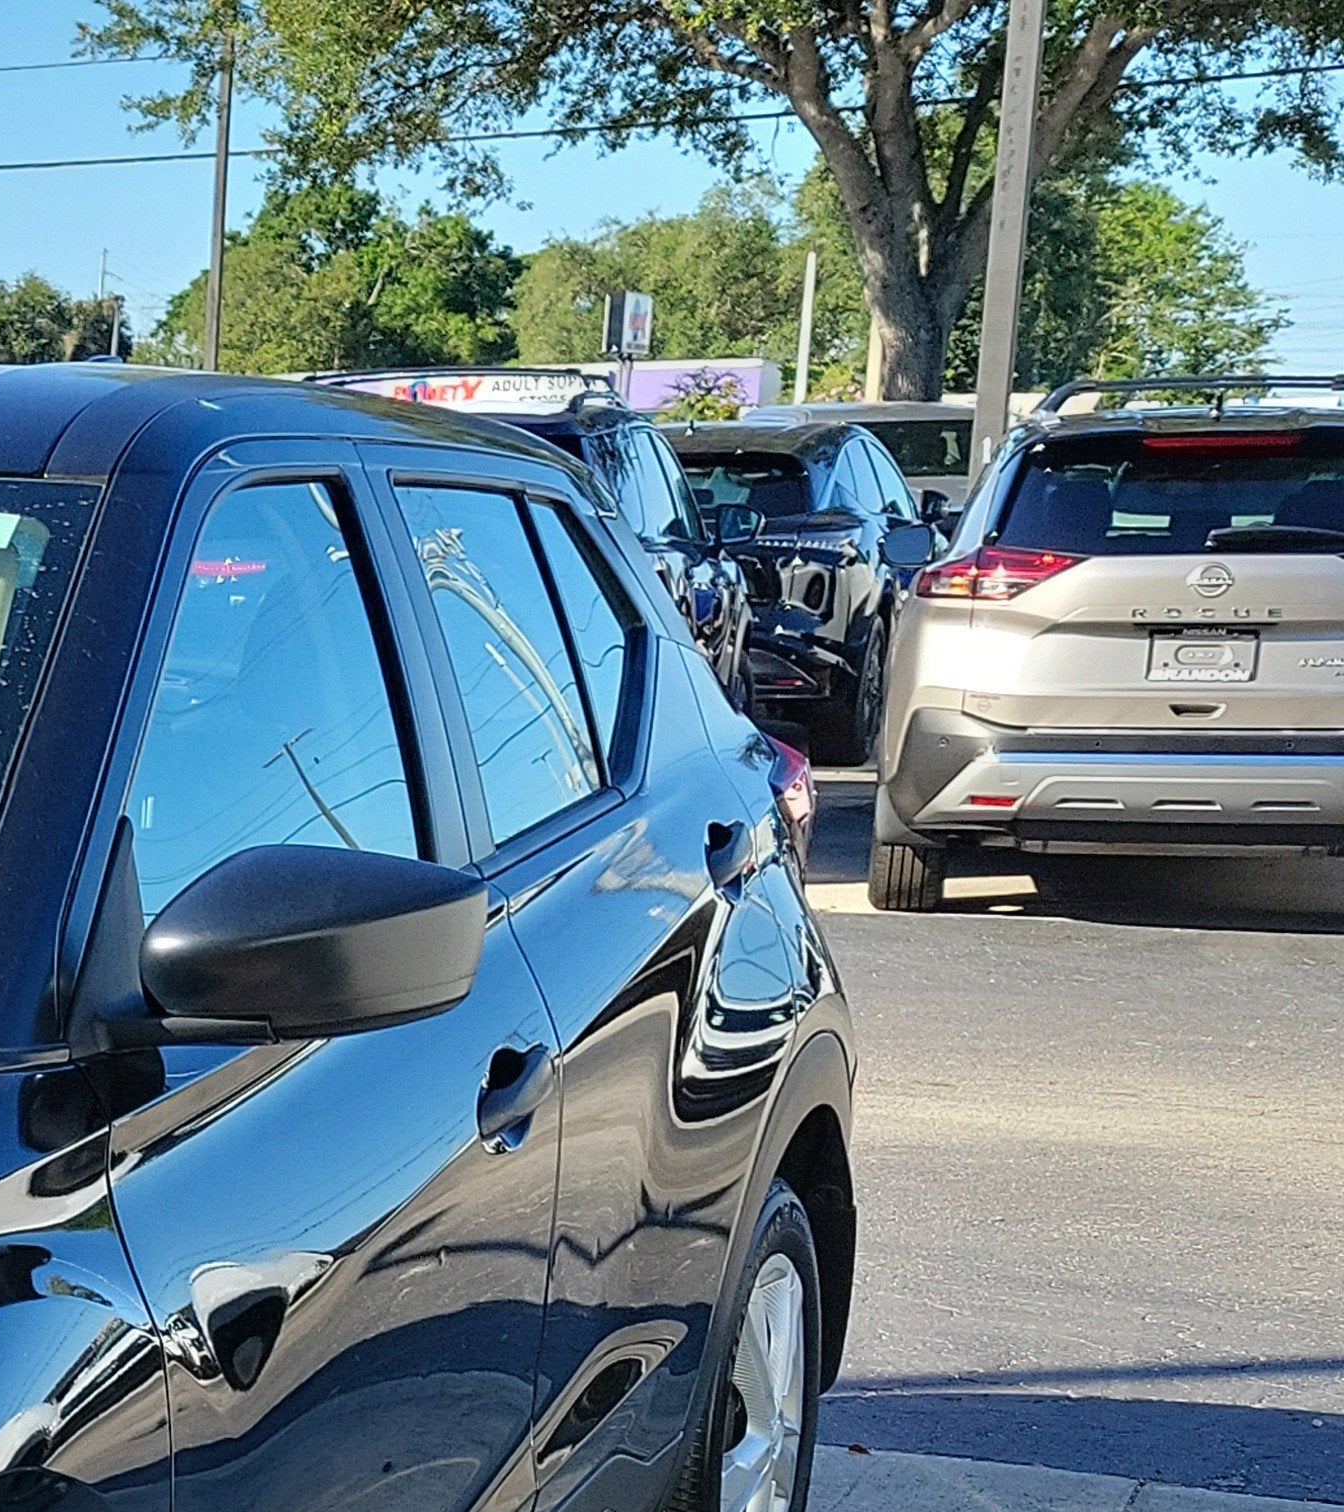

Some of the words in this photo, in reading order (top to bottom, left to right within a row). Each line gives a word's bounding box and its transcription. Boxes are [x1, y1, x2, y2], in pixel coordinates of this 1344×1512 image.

[1130, 607, 1284, 619] ROGUE
[1181, 628, 1228, 637] NISSAN
[1147, 668, 1253, 682] BRANDON
